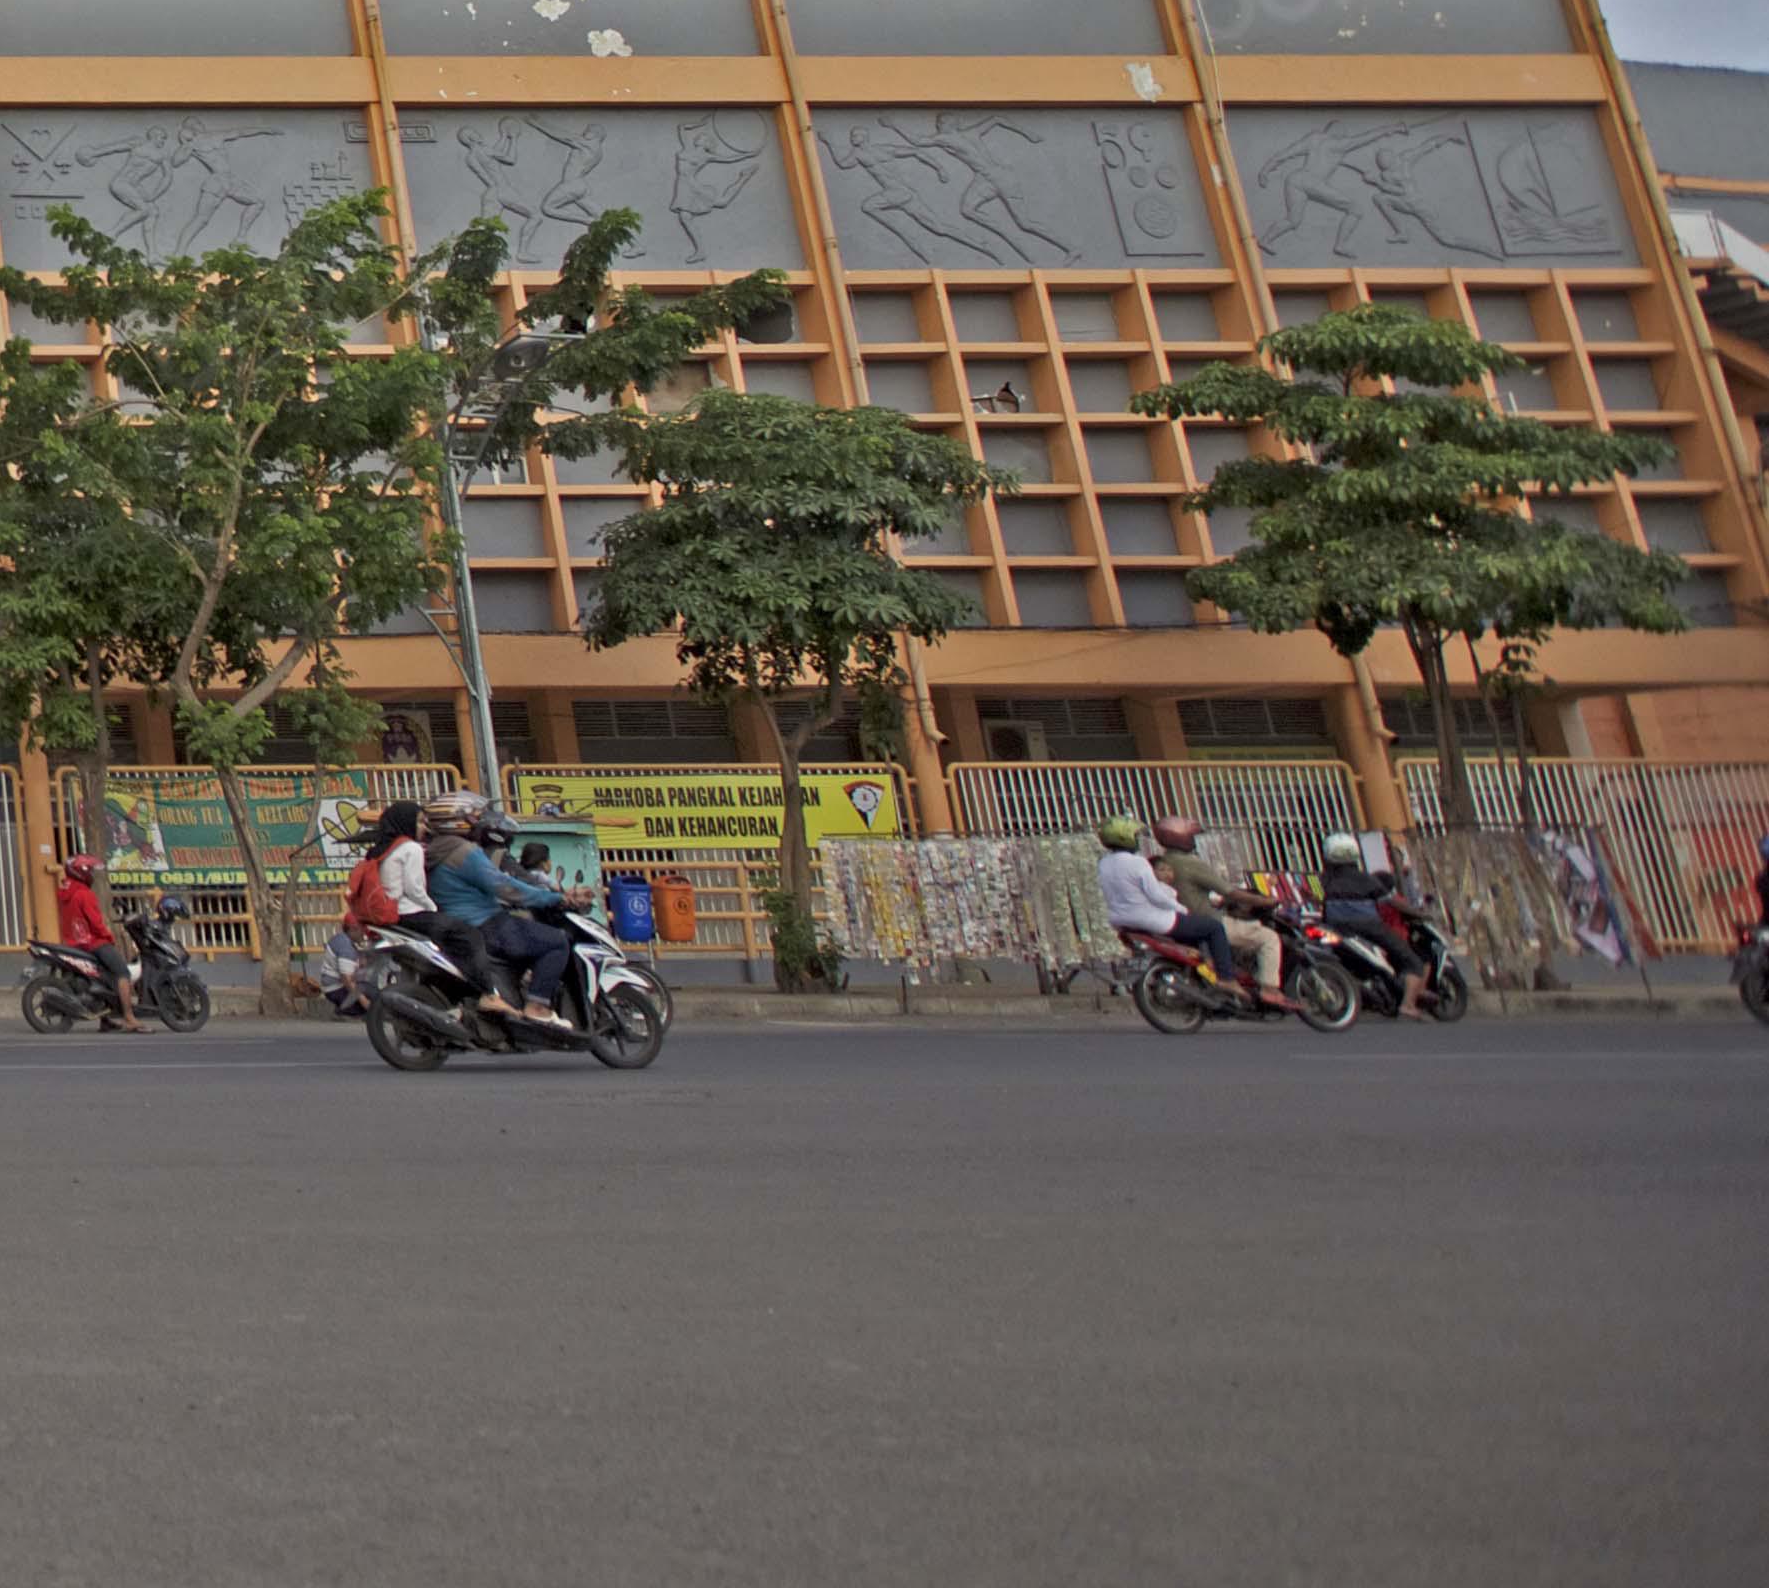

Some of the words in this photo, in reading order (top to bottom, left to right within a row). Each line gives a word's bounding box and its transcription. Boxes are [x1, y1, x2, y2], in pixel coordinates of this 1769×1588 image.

[594, 786, 666, 808] NARKOBA
[667, 786, 735, 808] PANGKAL
[738, 785, 821, 808] KEJAHAN
[644, 816, 675, 838] DAN
[677, 815, 780, 838] KEHANCURAN
